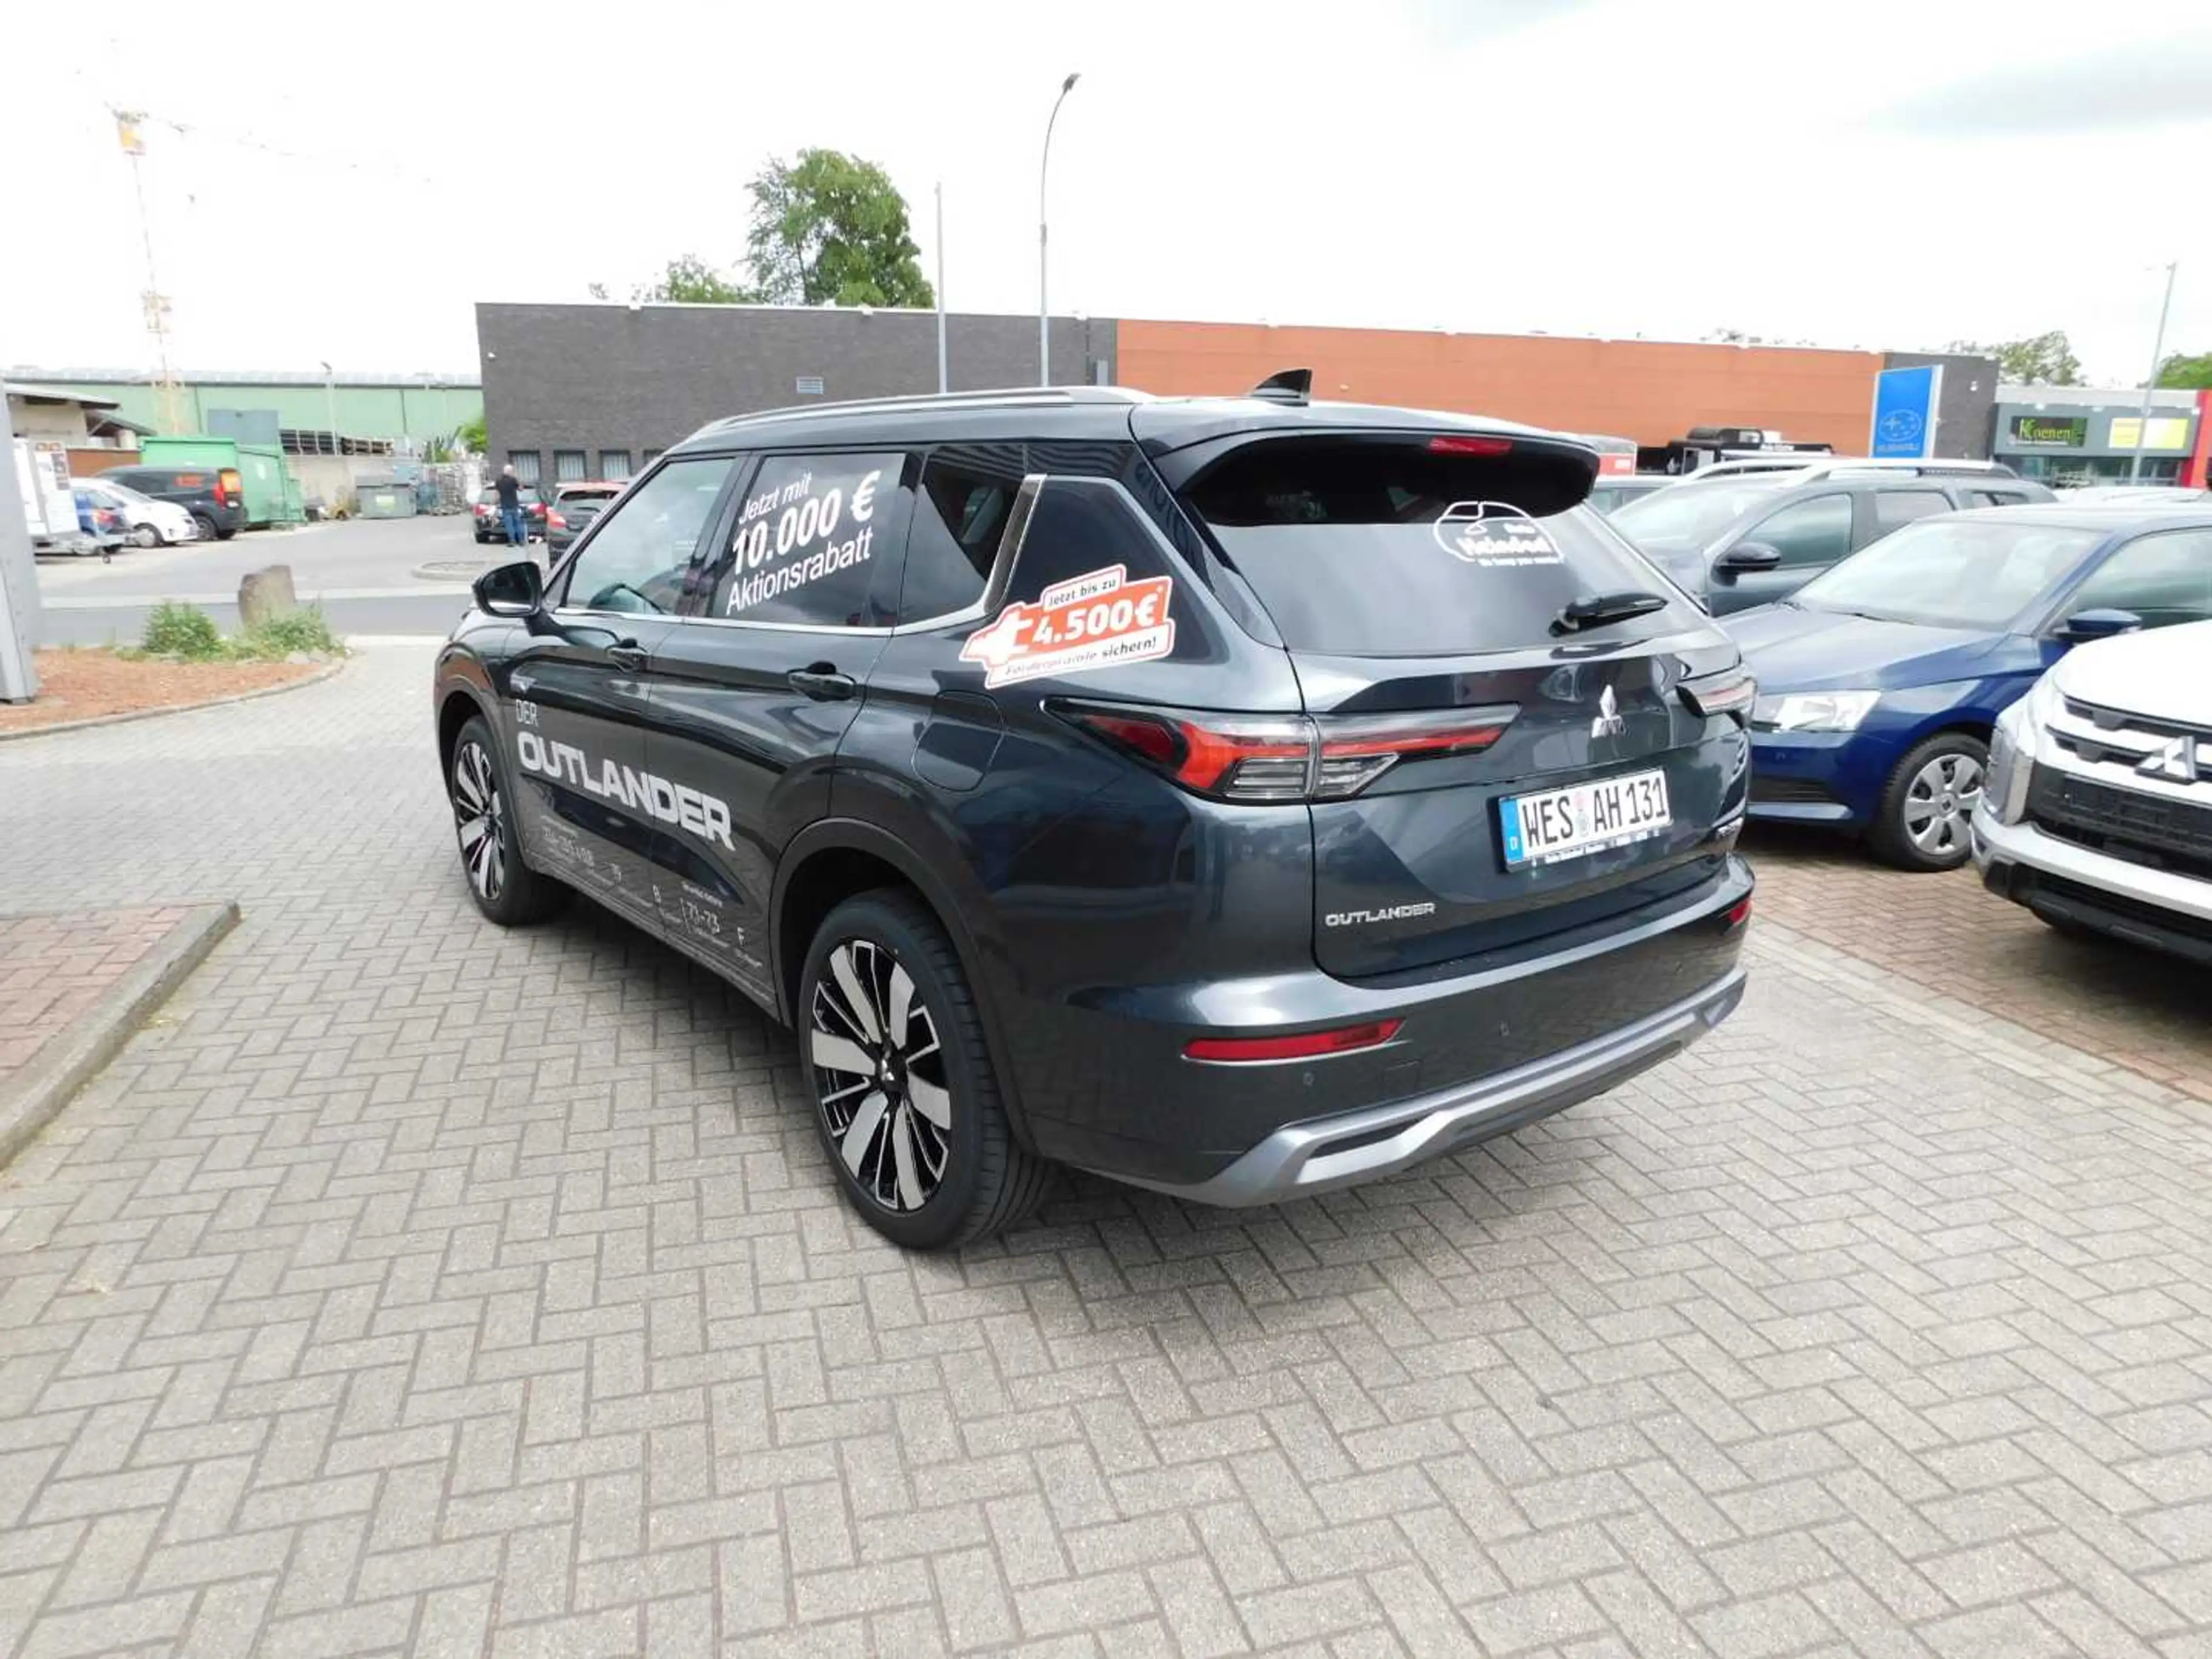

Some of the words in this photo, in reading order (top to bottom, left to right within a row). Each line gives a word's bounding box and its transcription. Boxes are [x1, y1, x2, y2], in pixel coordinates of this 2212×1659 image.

[732, 488, 841, 575] 10.000
[850, 470, 881, 522] €
[738, 490, 779, 524] Jetzt
[783, 471, 812, 503] mit
[725, 527, 873, 616] Aktionsrabatt
[1080, 584, 1098, 600] bis
[1103, 578, 1116, 590] zu
[516, 699, 539, 728] DER
[517, 731, 736, 851] OUTLANDER
[1522, 796, 1574, 847] WES
[1593, 786, 1623, 833] AH
[1626, 777, 1666, 824] 131
[1325, 902, 1435, 927] OUTLANDER
